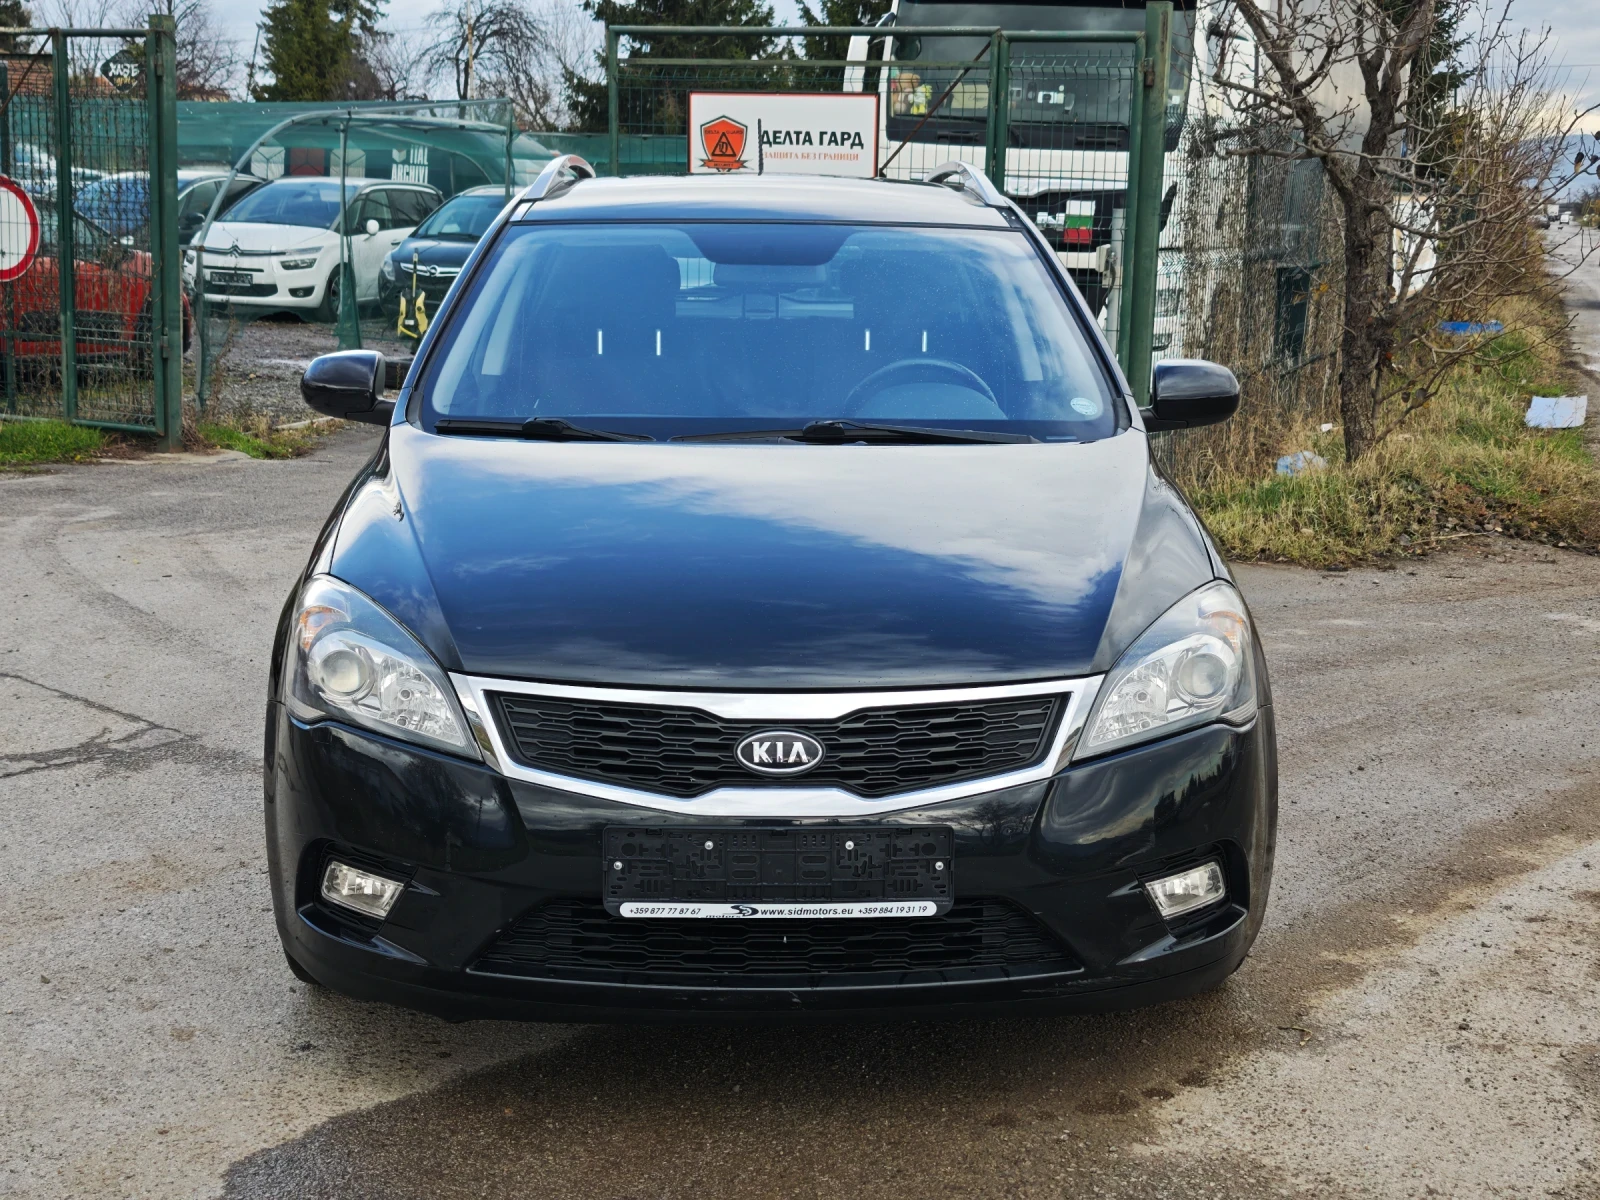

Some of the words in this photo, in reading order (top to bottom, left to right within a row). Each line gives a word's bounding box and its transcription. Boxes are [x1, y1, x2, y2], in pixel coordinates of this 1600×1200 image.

[761, 130, 813, 148] ДЕЛТА
[819, 131, 864, 150] ГАРД
[764, 152, 799, 160] ЗАЩИТА
[818, 153, 859, 161] ГРАНИЦИ
[751, 741, 809, 764] KIA
[629, 907, 649, 915] +359
[650, 907, 665, 915] 877
[667, 907, 678, 915] 77
[679, 907, 690, 915] 87
[690, 907, 701, 915] 67
[760, 907, 854, 916] www.sidmotors.eu
[858, 906, 878, 915] +359
[878, 906, 894, 915] 884
[896, 906, 905, 914] 19
[905, 905, 915, 914] 31
[918, 905, 928, 913] 19
